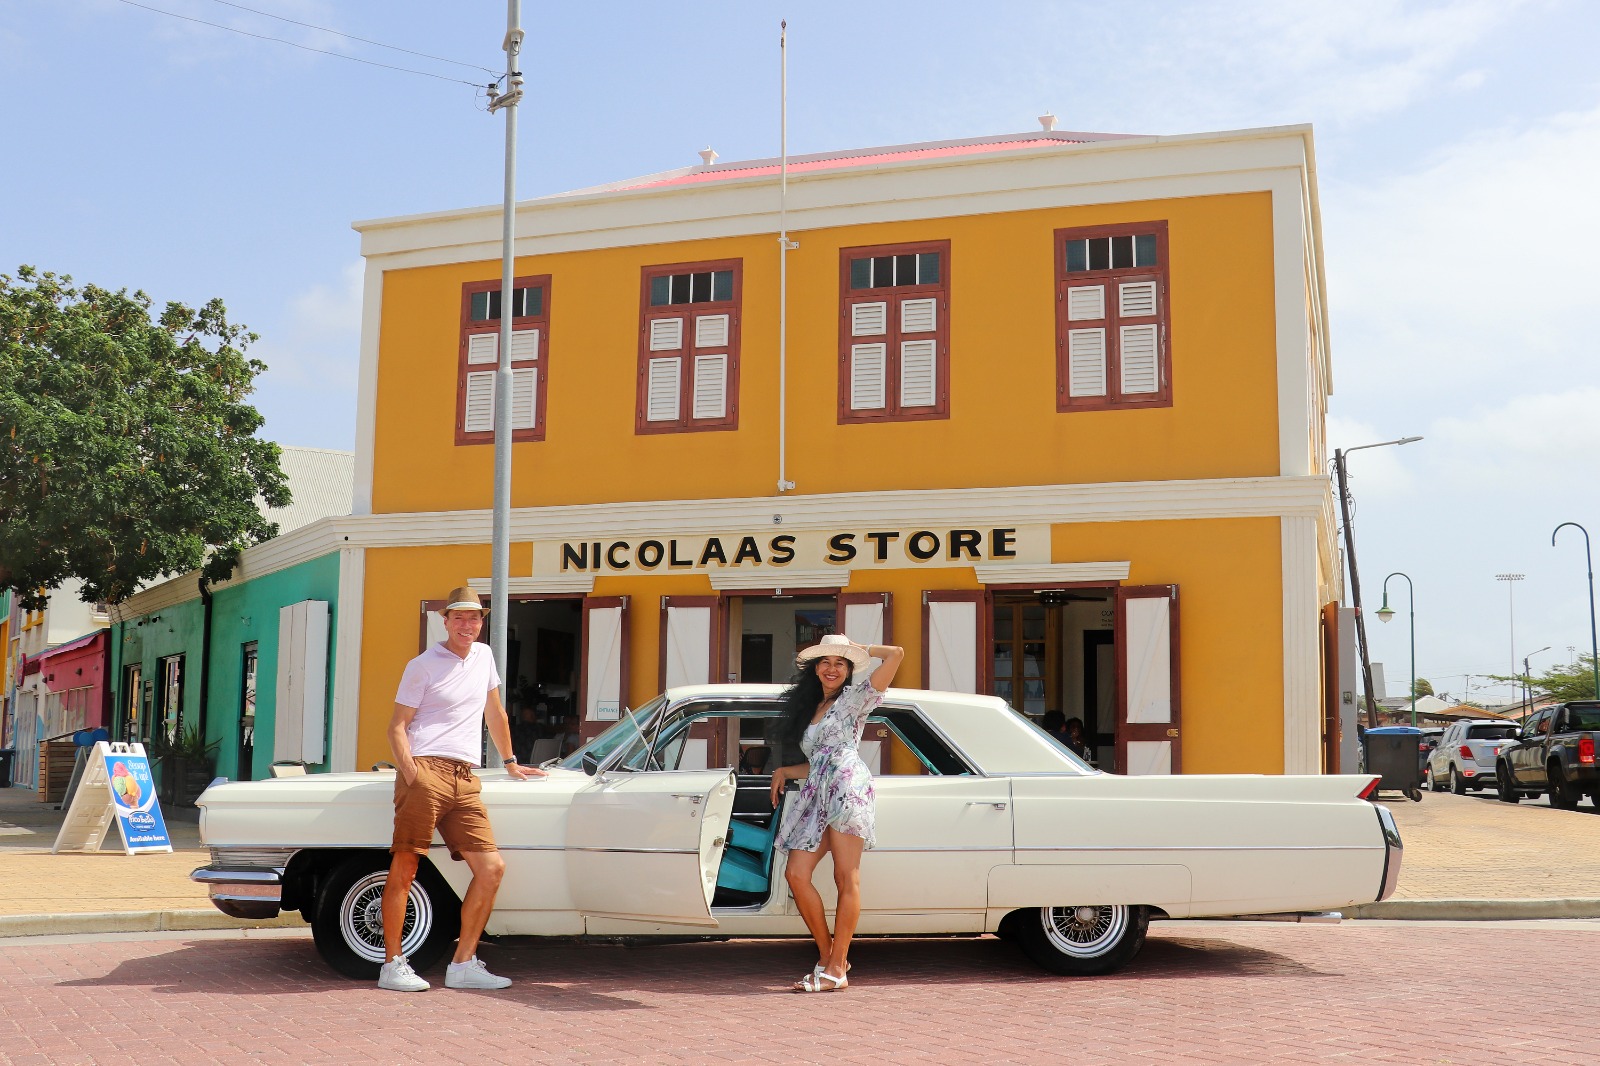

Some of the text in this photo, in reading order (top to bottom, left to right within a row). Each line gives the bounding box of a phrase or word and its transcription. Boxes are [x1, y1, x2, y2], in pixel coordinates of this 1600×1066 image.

[560, 528, 1016, 572] NICOLAAS STORE
[128, 760, 146, 772] Scoop
